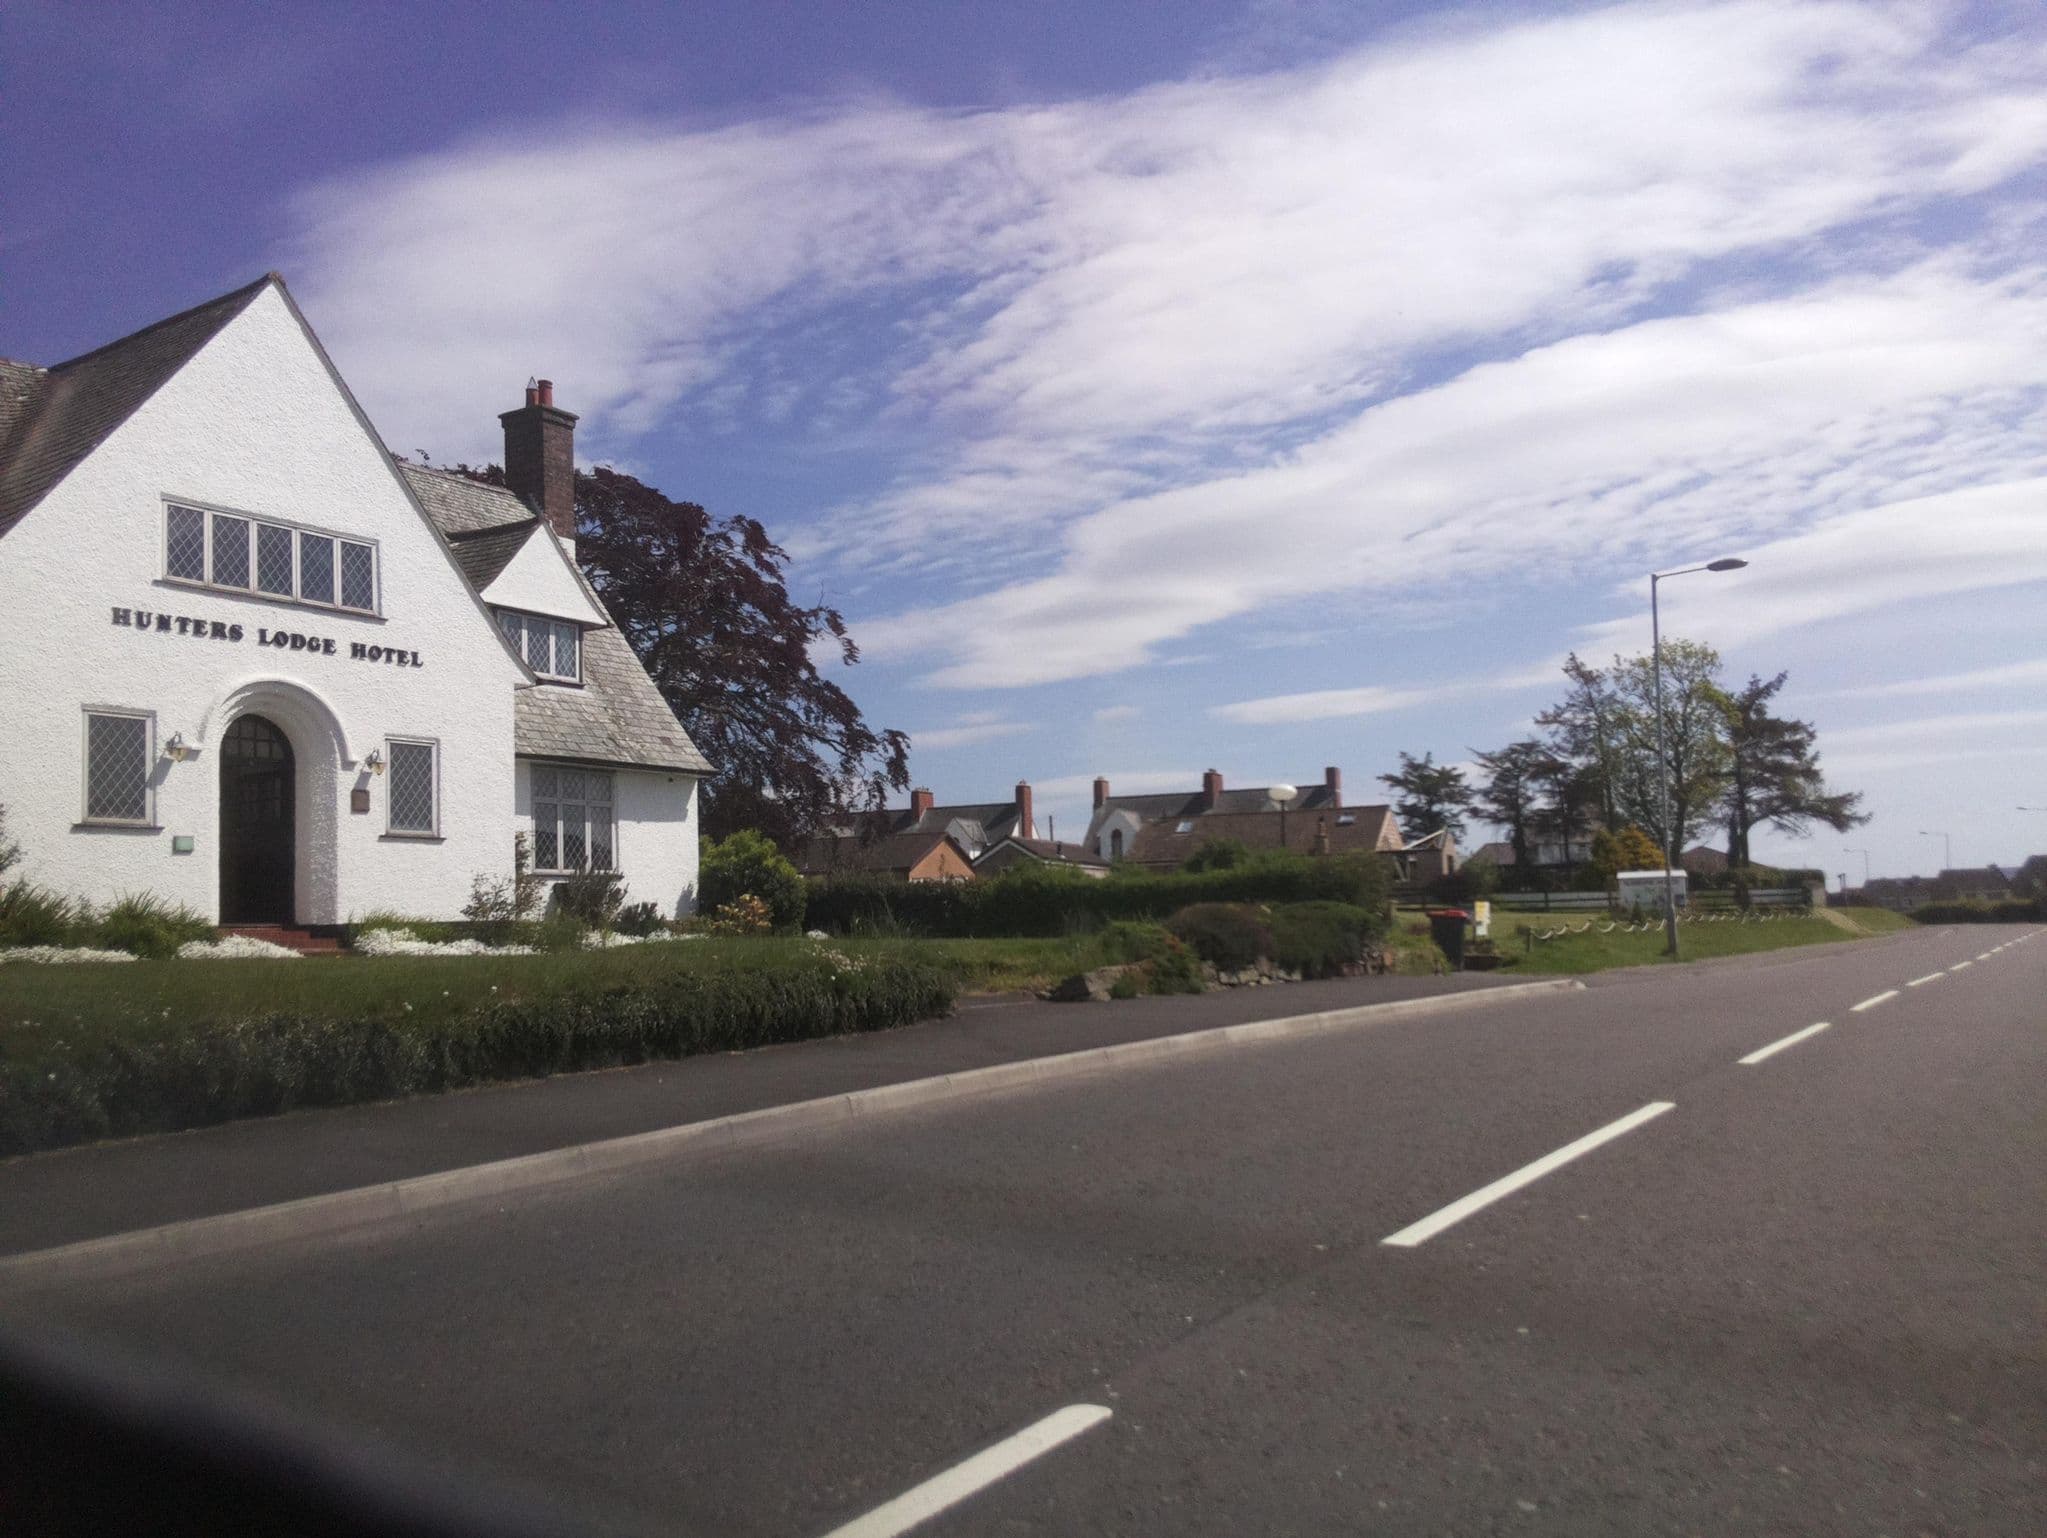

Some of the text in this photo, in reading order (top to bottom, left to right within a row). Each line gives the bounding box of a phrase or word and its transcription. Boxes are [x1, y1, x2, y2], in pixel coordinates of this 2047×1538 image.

[111, 606, 424, 668] HUNTERS LODGE HOTEL
